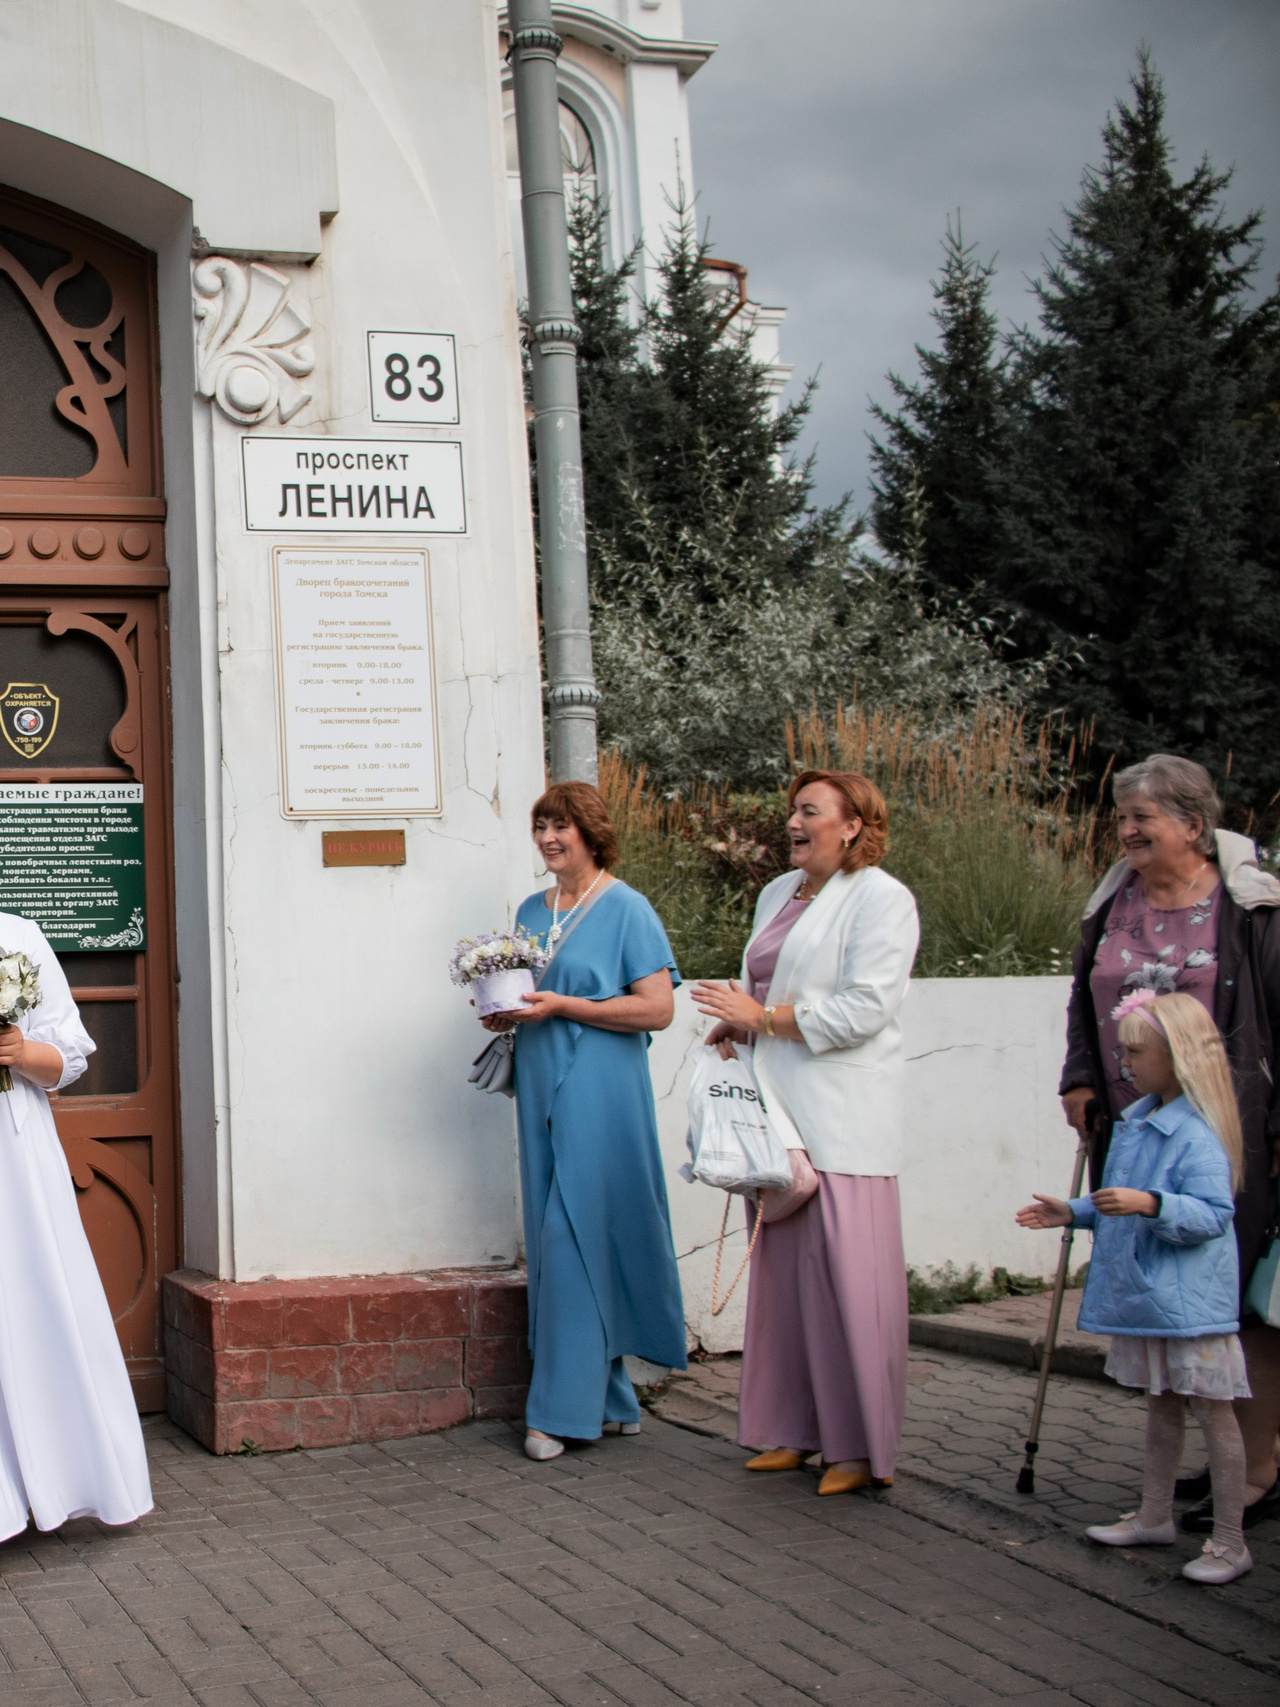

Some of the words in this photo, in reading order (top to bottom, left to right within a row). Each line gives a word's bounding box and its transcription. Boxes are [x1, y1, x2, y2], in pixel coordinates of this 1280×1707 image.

[385, 353, 444, 402] 83
[296, 452, 409, 475] проспект
[279, 483, 436, 519] ЛЕНИНА
[284, 559, 334, 567] Департамент
[296, 578, 331, 587] Дворец
[333, 578, 409, 587] бракосочетаний
[320, 590, 352, 599] города
[355, 590, 388, 598] Томска
[319, 619, 345, 627] Прием
[348, 619, 391, 627] заявлений
[331, 678, 364, 686] четверг
[55, 788, 140, 801] граждане!
[100, 806, 127, 815] брака
[0, 844, 57, 853] убедительно
[59, 845, 94, 853] просим:
[350, 841, 404, 852] КУРИТЬ
[5, 858, 67, 867] новобрачных
[47, 875, 81, 883] бокалы
[54, 890, 118, 899] пиротехникой
[20, 909, 77, 918] территории.
[42, 922, 96, 930] благодарим
